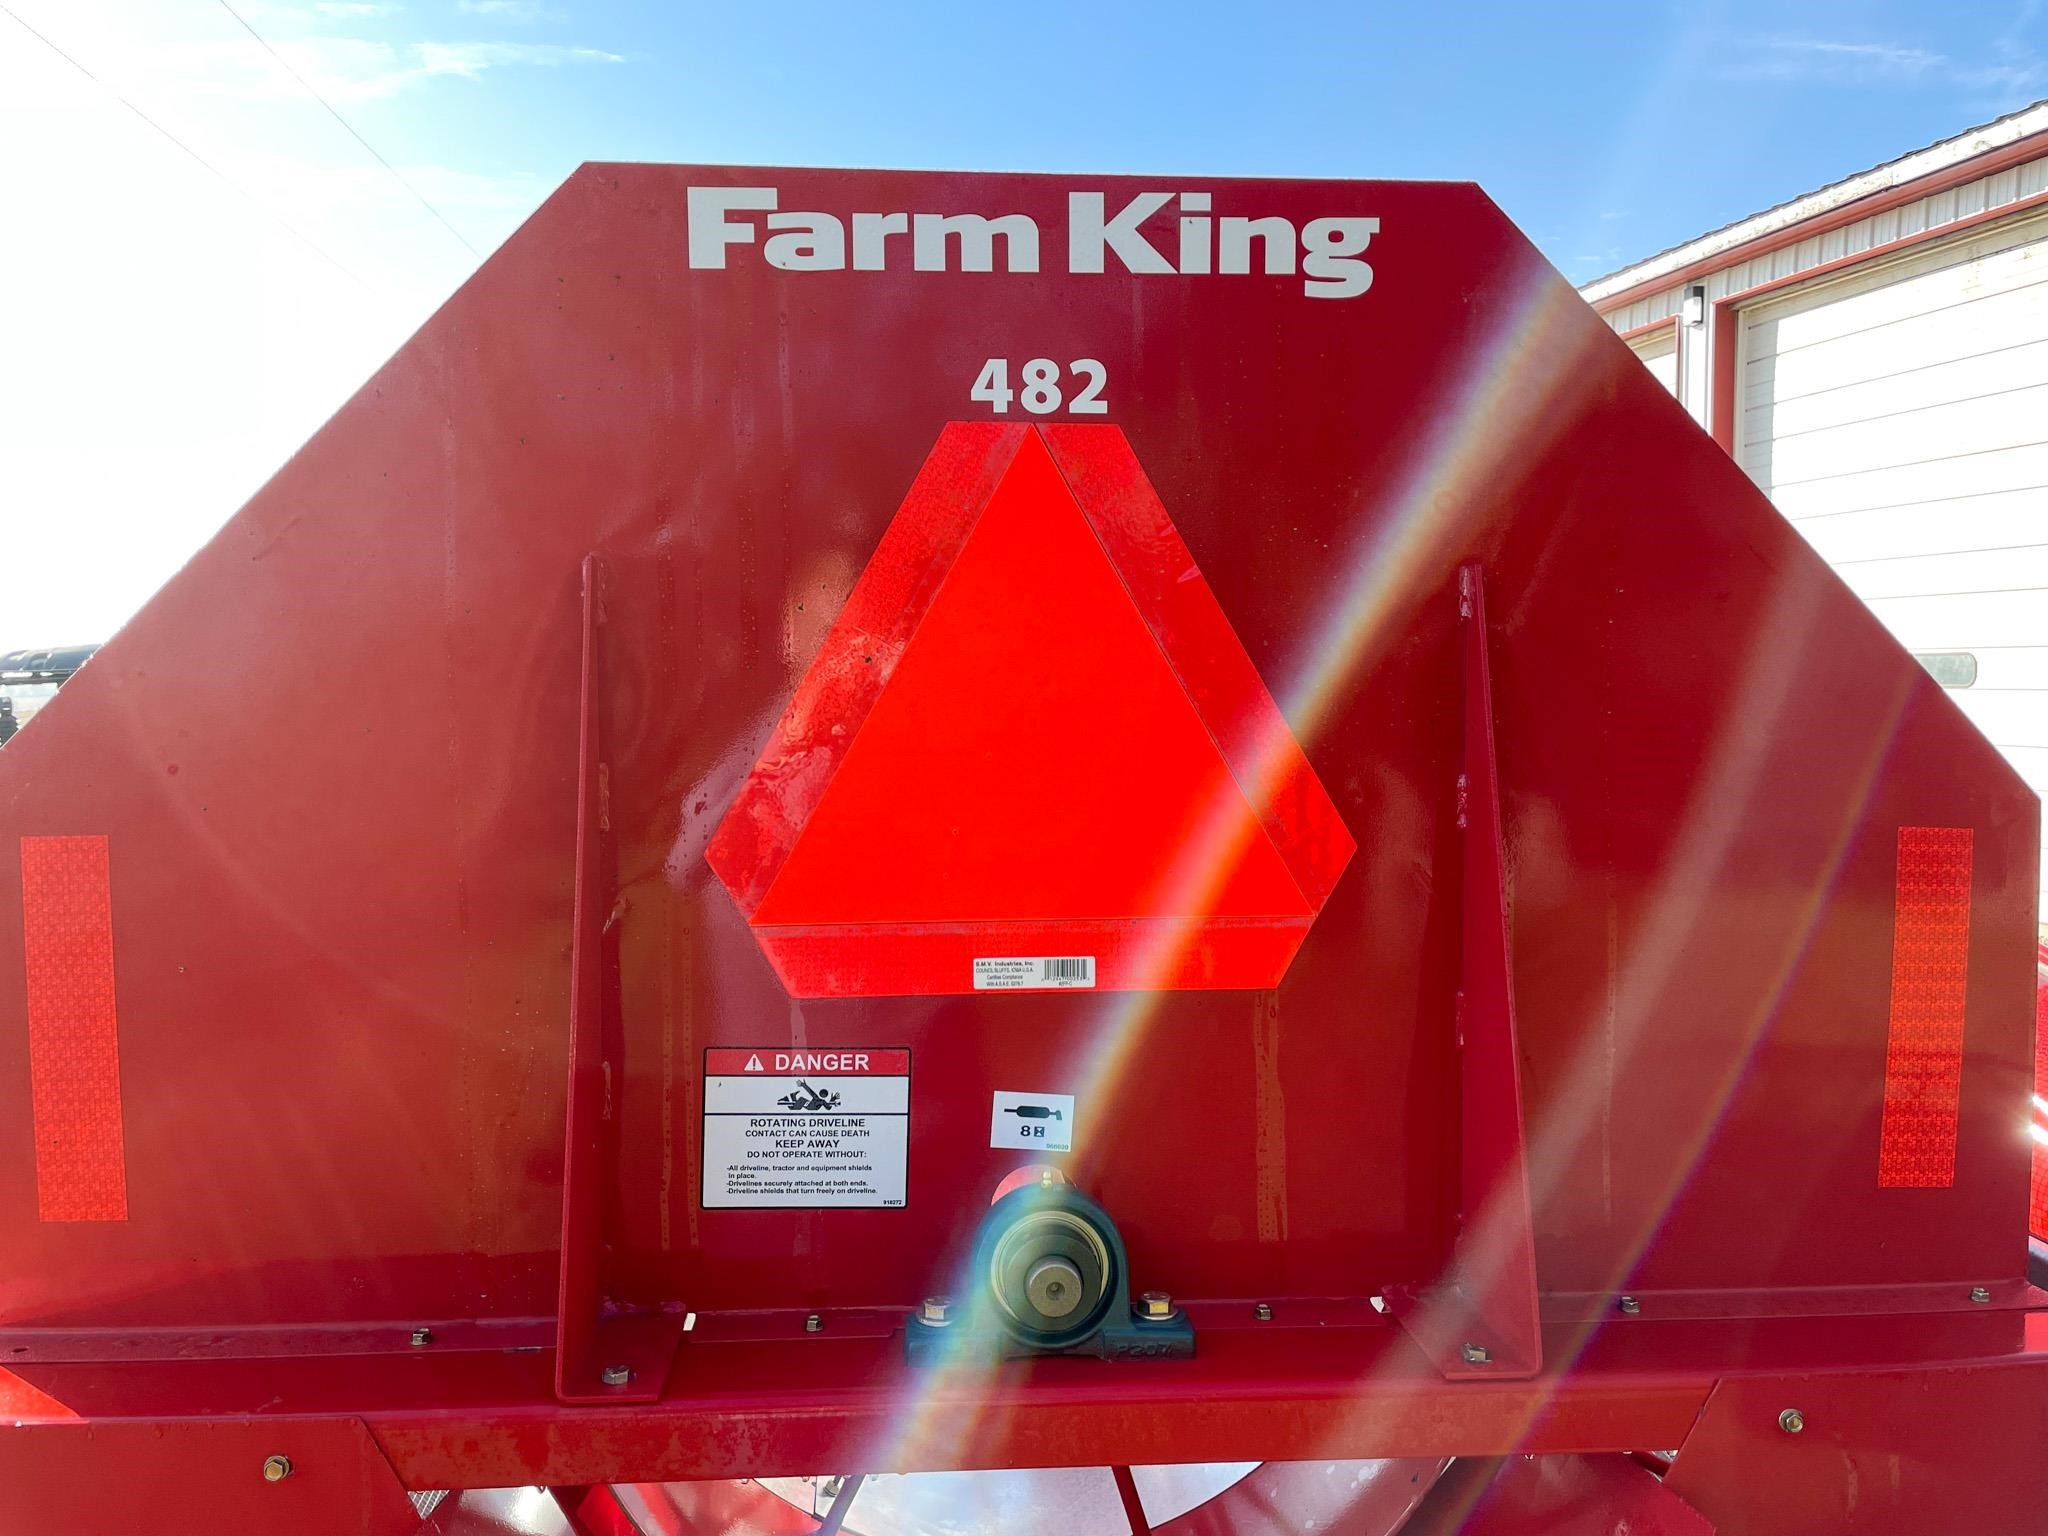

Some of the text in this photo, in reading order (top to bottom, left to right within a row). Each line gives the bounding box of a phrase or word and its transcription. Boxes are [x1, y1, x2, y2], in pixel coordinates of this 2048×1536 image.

[687, 186, 1380, 298] Farm King
[970, 358, 1108, 415] 482
[775, 1054, 869, 1071] DANGER
[750, 1119, 865, 1127] ROTATING DRIVELINE
[1020, 1125, 1031, 1136] 8
[775, 1140, 840, 1148] KEEP AWAY
[811, 1165, 847, 1173] equipment
[764, 1180, 792, 1188] securely
[760, 1187, 784, 1195] shields
[786, 1187, 799, 1195] that
[816, 1187, 835, 1196] freely
[847, 1187, 878, 1195] driveline.
